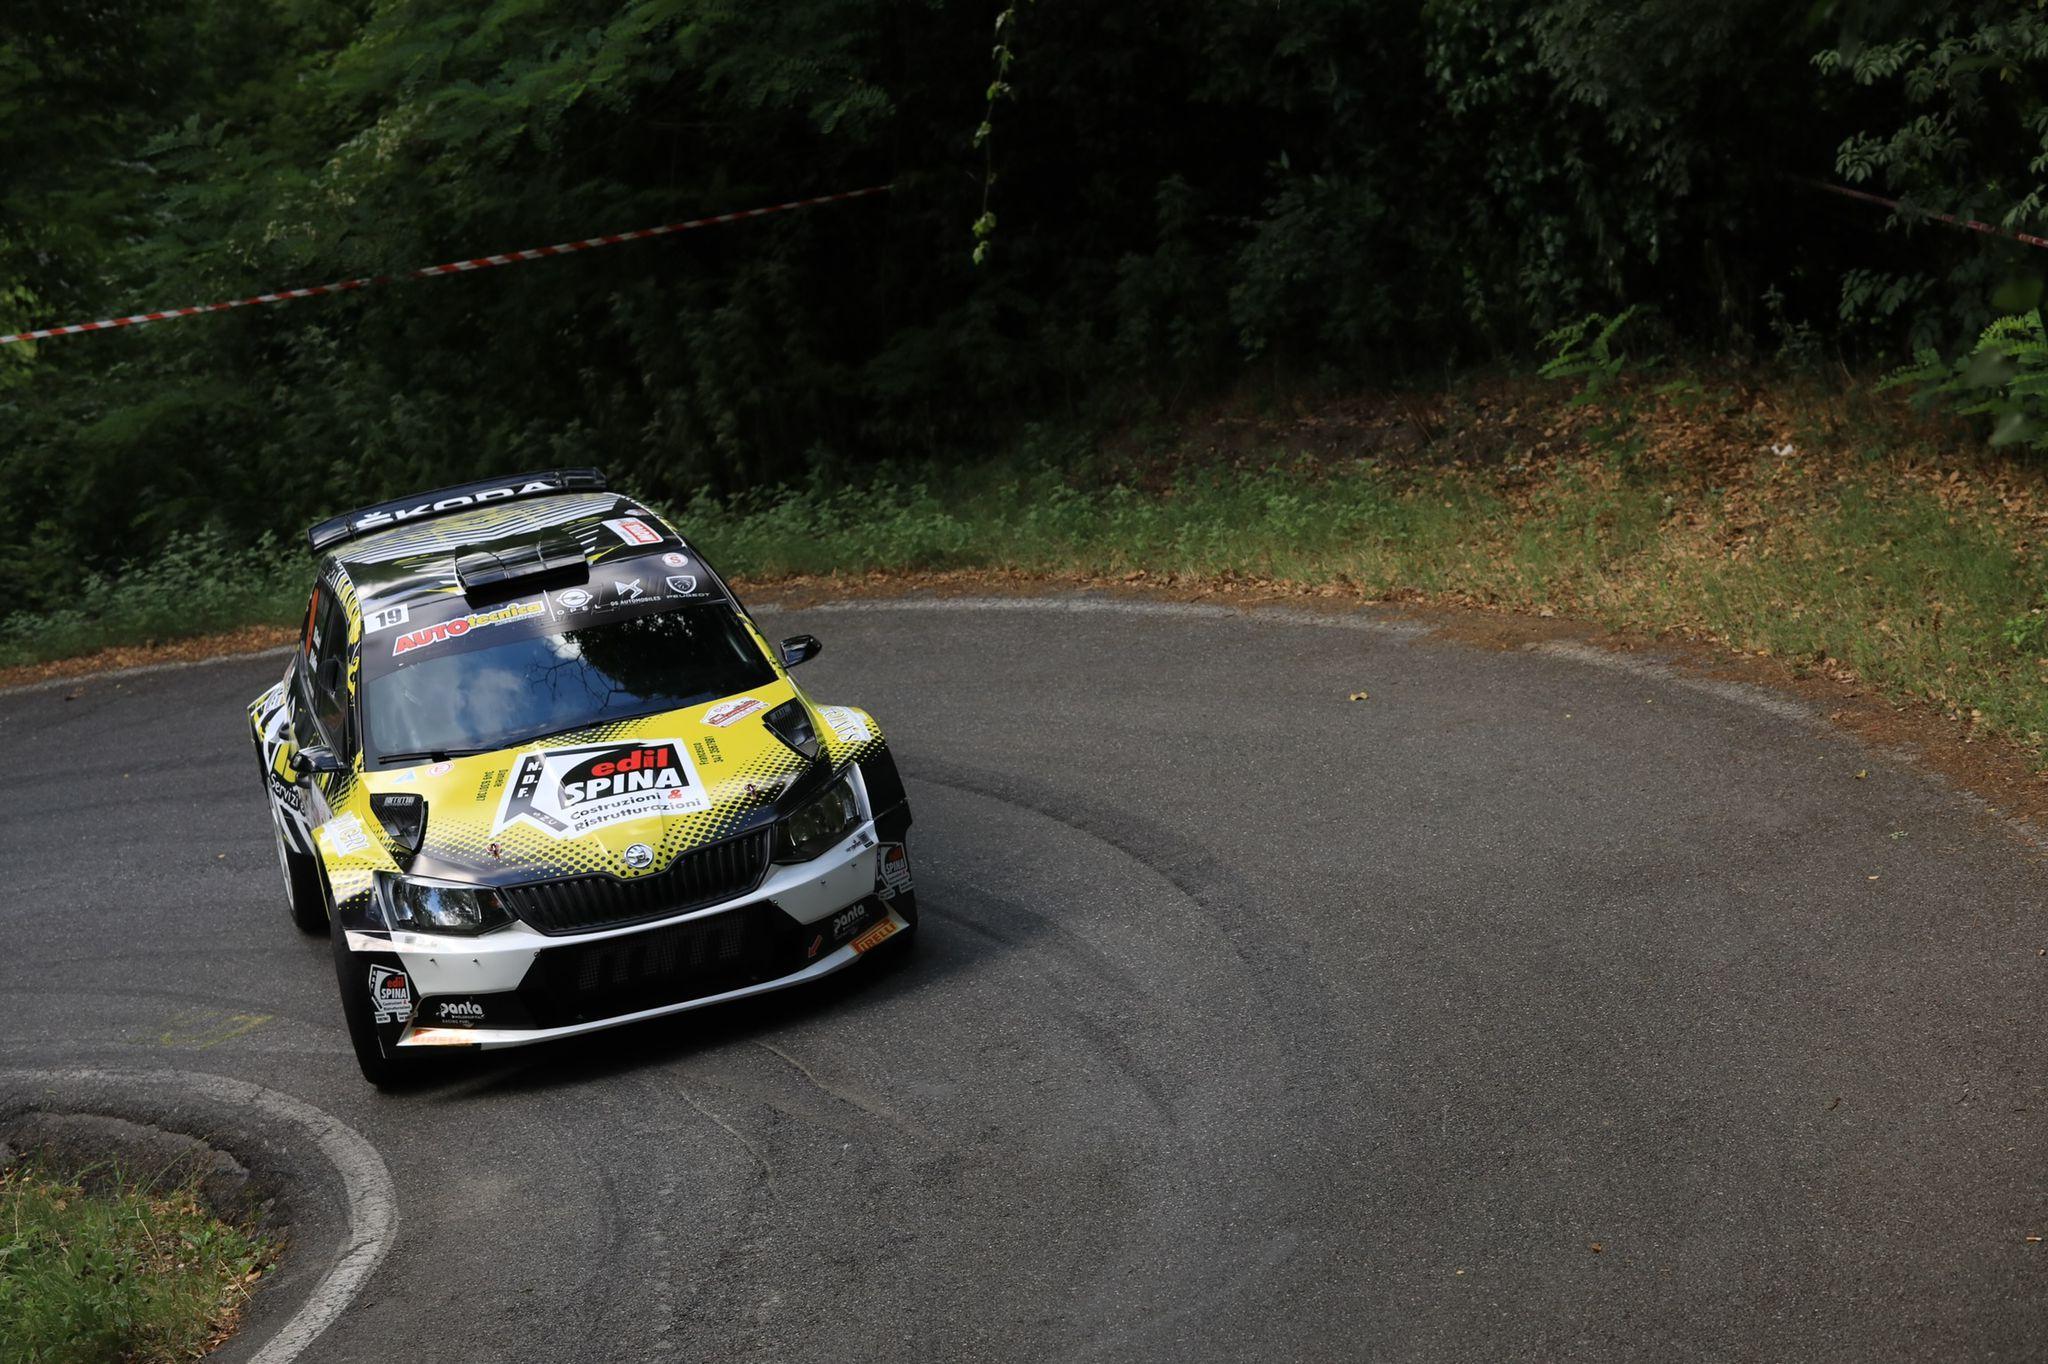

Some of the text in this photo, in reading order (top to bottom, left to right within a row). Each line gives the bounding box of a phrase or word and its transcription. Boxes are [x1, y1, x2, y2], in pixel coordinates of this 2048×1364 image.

[375, 607, 402, 628] 19
[591, 748, 668, 777] edil
[270, 772, 300, 808] Servizi
[564, 767, 683, 807] SPINA
[570, 789, 682, 820] Costruzioni &
[574, 798, 702, 832] Ristrutturazioni
[381, 988, 407, 999] SPINA
[440, 1001, 483, 1018] panta
